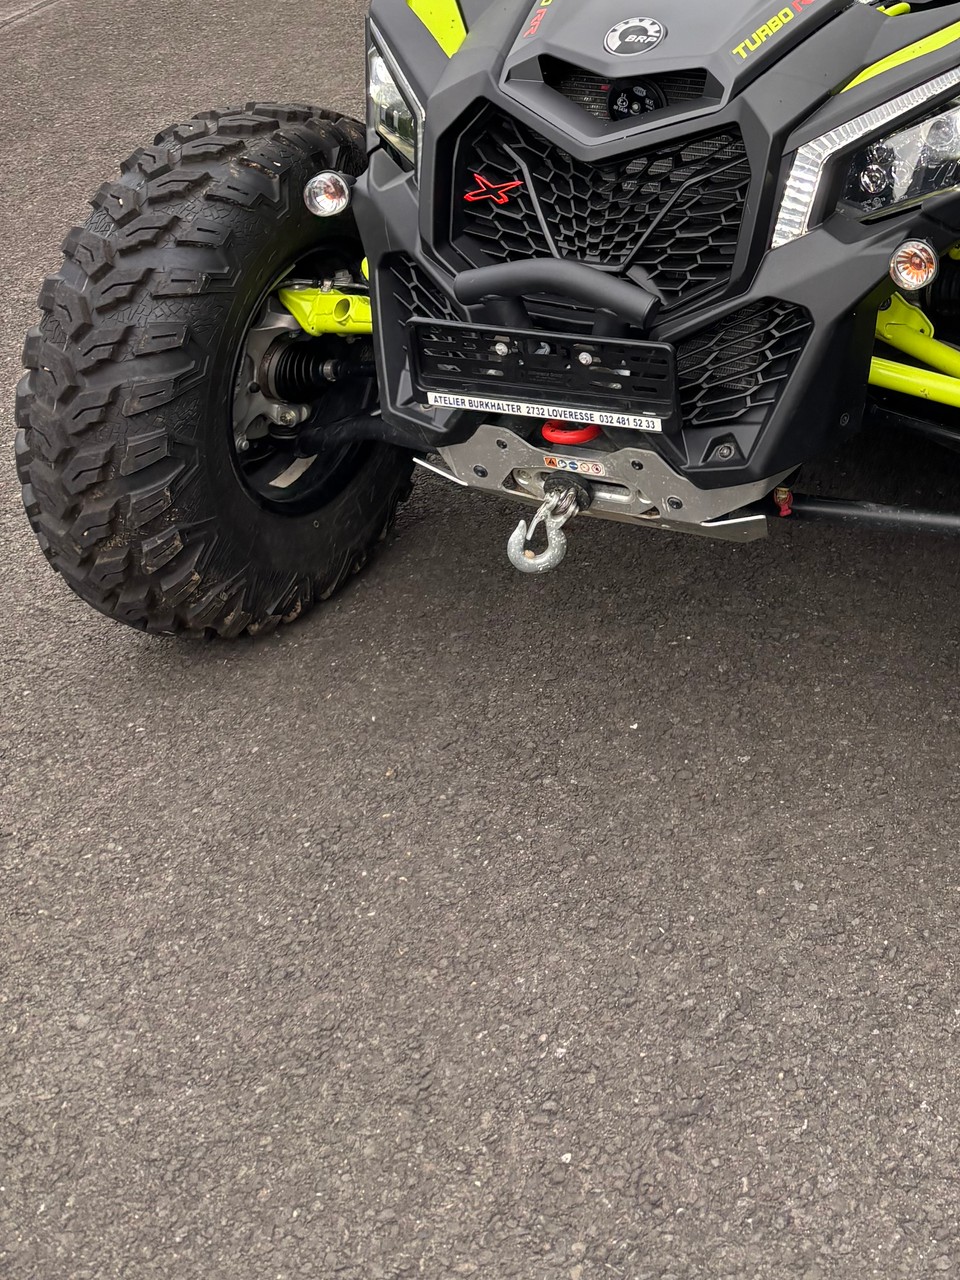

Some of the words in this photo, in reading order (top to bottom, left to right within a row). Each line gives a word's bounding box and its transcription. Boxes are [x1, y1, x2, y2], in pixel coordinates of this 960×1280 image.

[523, 7, 548, 38] RR
[624, 33, 658, 45] BRP
[731, 6, 795, 60] TURBO
[433, 395, 467, 407] ATELIER
[468, 399, 522, 414] BURKHALTER
[526, 406, 545, 416] 2732
[547, 408, 595, 422] LOVERESSE
[599, 414, 614, 424] 032
[616, 416, 631, 427] 481
[633, 418, 643, 428] 52
[645, 420, 656, 430] 33
